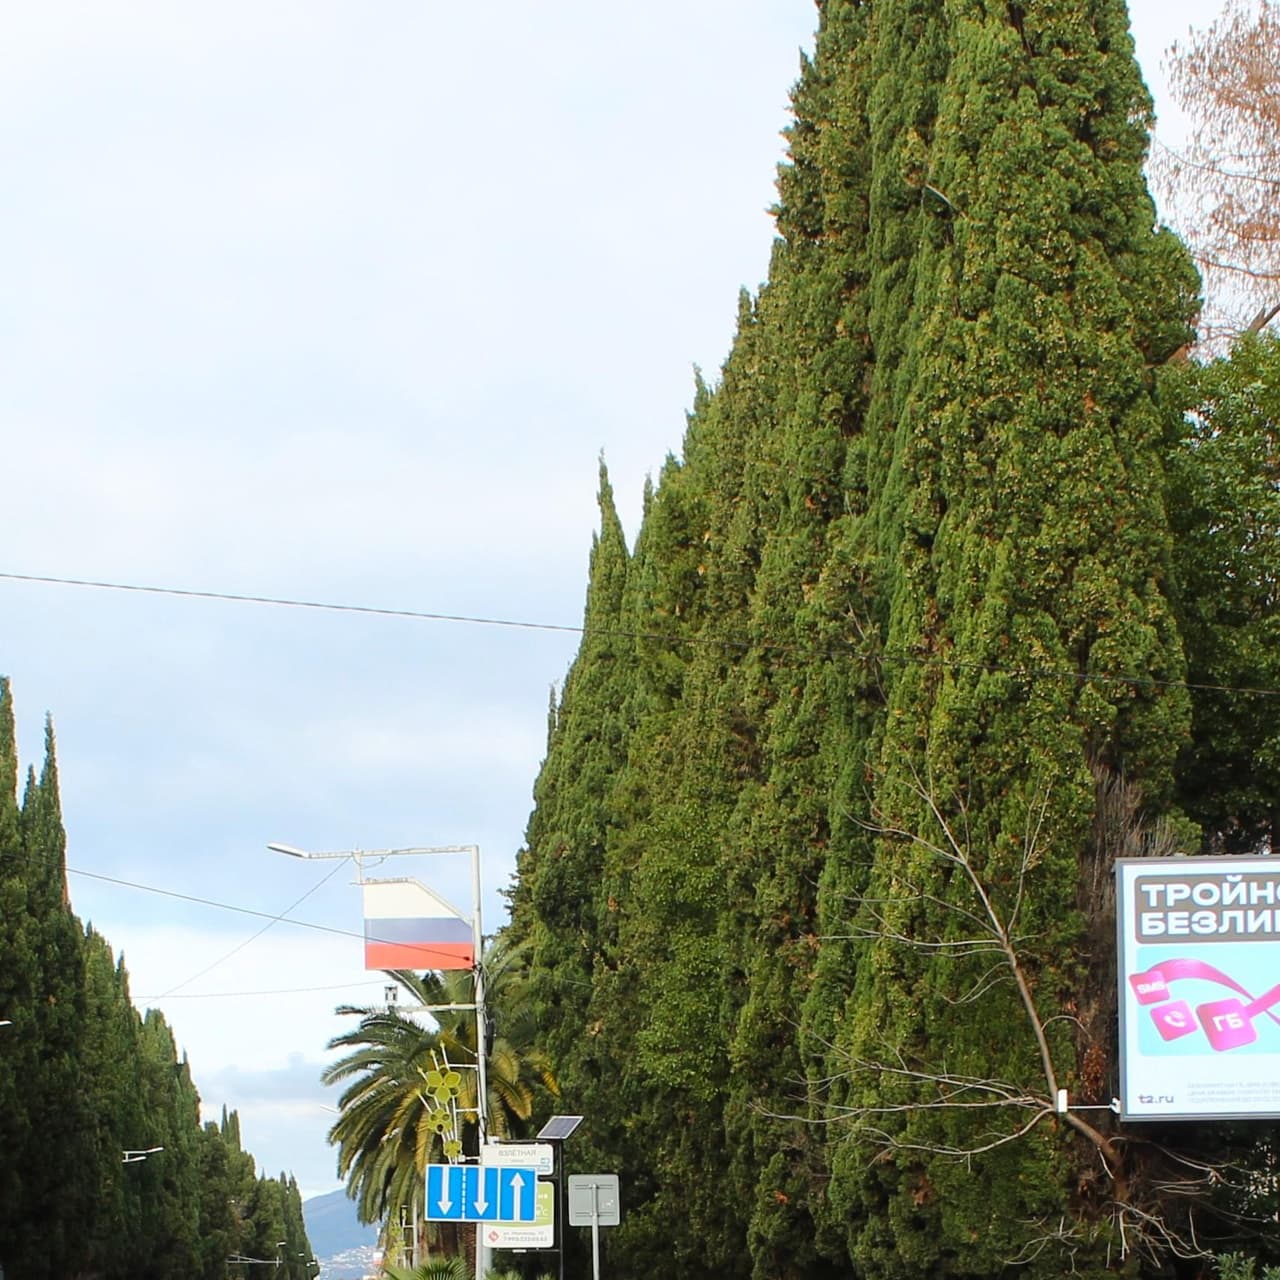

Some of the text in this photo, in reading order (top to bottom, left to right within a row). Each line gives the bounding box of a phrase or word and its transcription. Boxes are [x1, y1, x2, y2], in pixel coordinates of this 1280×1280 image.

[1136, 981, 1166, 994] SMS
[1212, 1012, 1244, 1032] ГБ
[1138, 1093, 1174, 1104] t2.ru
